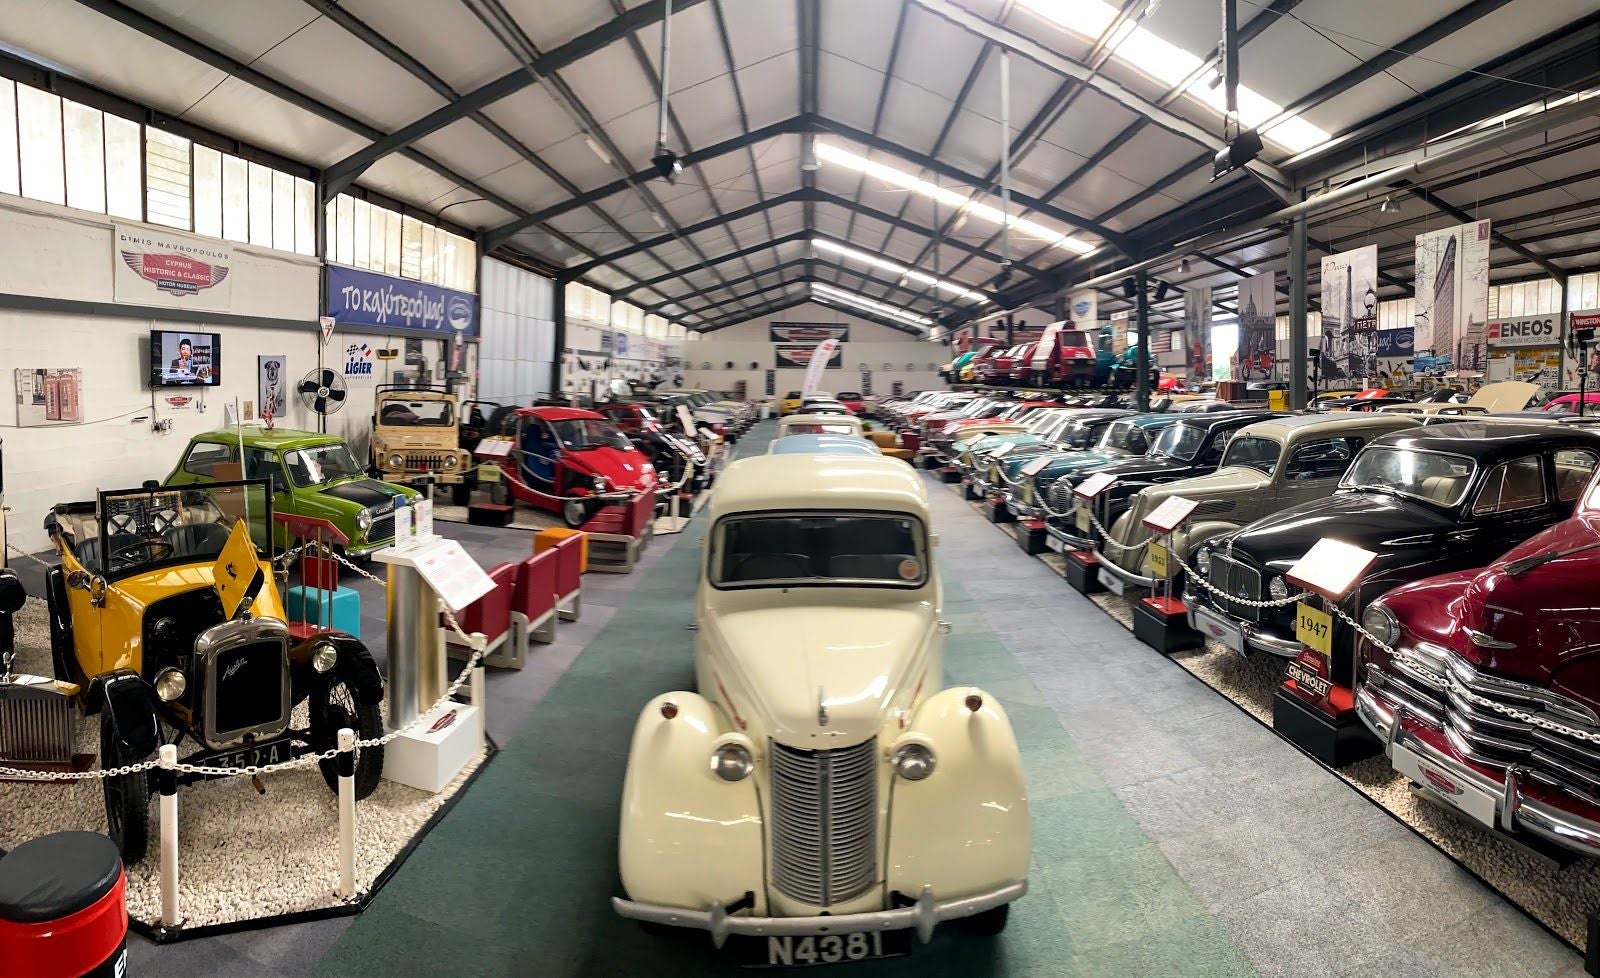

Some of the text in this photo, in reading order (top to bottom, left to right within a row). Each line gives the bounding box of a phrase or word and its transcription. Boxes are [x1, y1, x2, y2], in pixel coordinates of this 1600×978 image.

[120, 234, 229, 260] DIMIS MAVROPOULOS
[143, 266, 175, 277] HISTORIC
[183, 272, 210, 282] CLASSIC
[165, 260, 192, 269] CYPRUS
[158, 280, 175, 288] MOTOR
[1501, 318, 1553, 338] ENEOS
[1300, 615, 1328, 639] 1947
[1288, 666, 1328, 694] CHEVROLET
[768, 931, 883, 966] N4381
